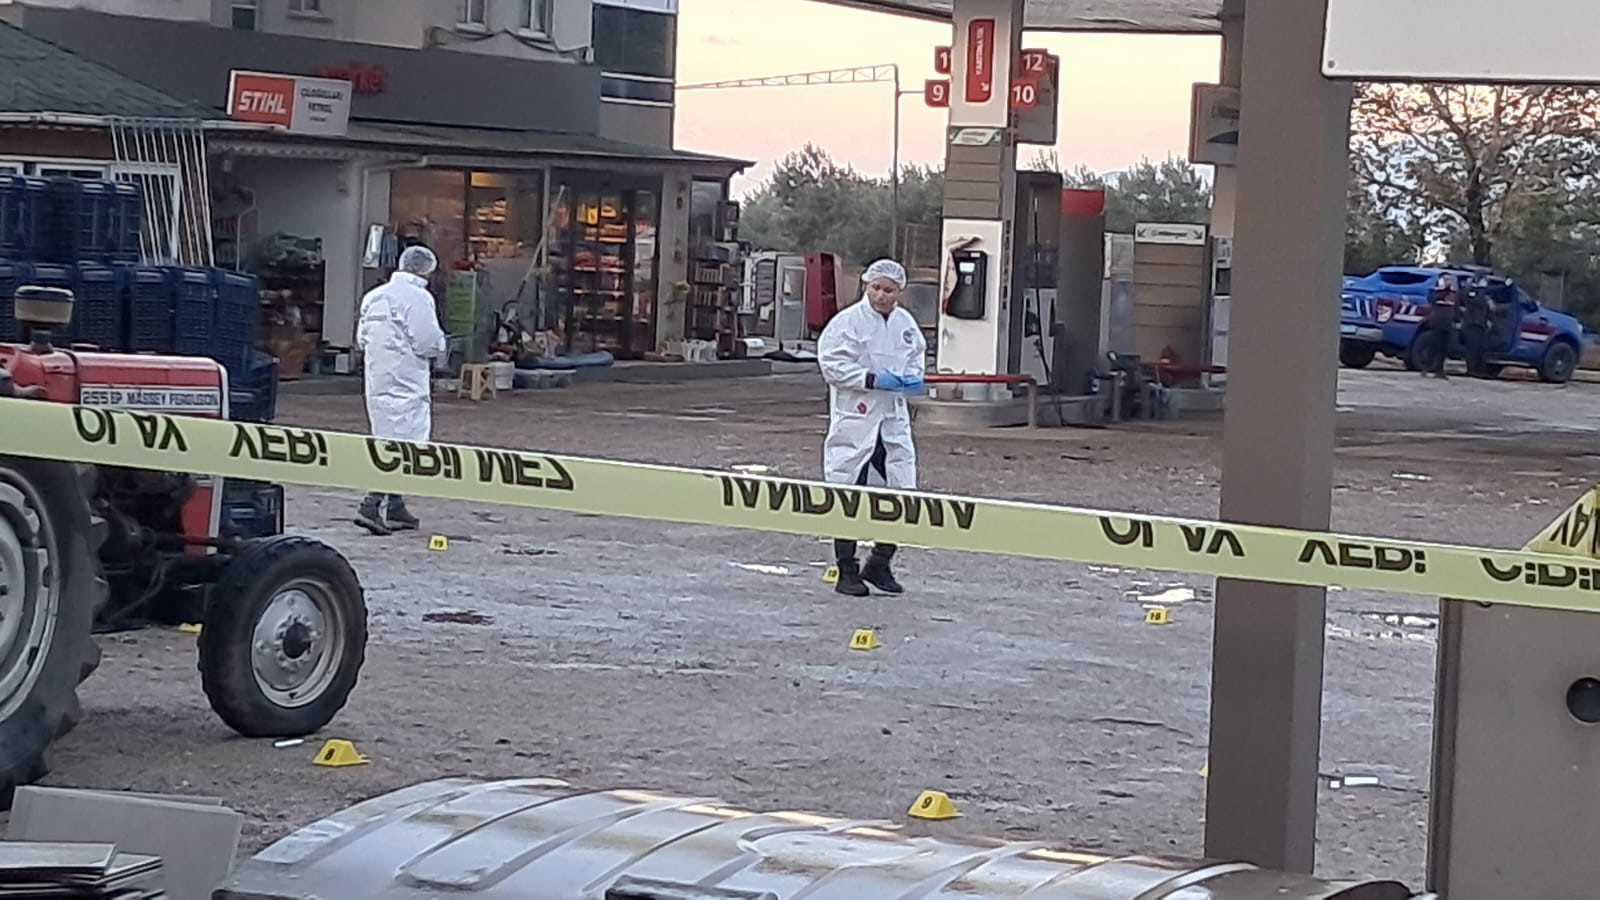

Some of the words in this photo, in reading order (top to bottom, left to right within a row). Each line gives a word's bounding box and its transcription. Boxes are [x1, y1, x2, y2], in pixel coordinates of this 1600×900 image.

[1024, 54, 1043, 71] 12
[932, 84, 944, 101] 9
[1012, 85, 1035, 103] 10
[238, 90, 287, 114] STIHL
[127, 391, 166, 405] MASSEY
[170, 392, 218, 406] FERGUSON
[921, 796, 933, 809] 9
